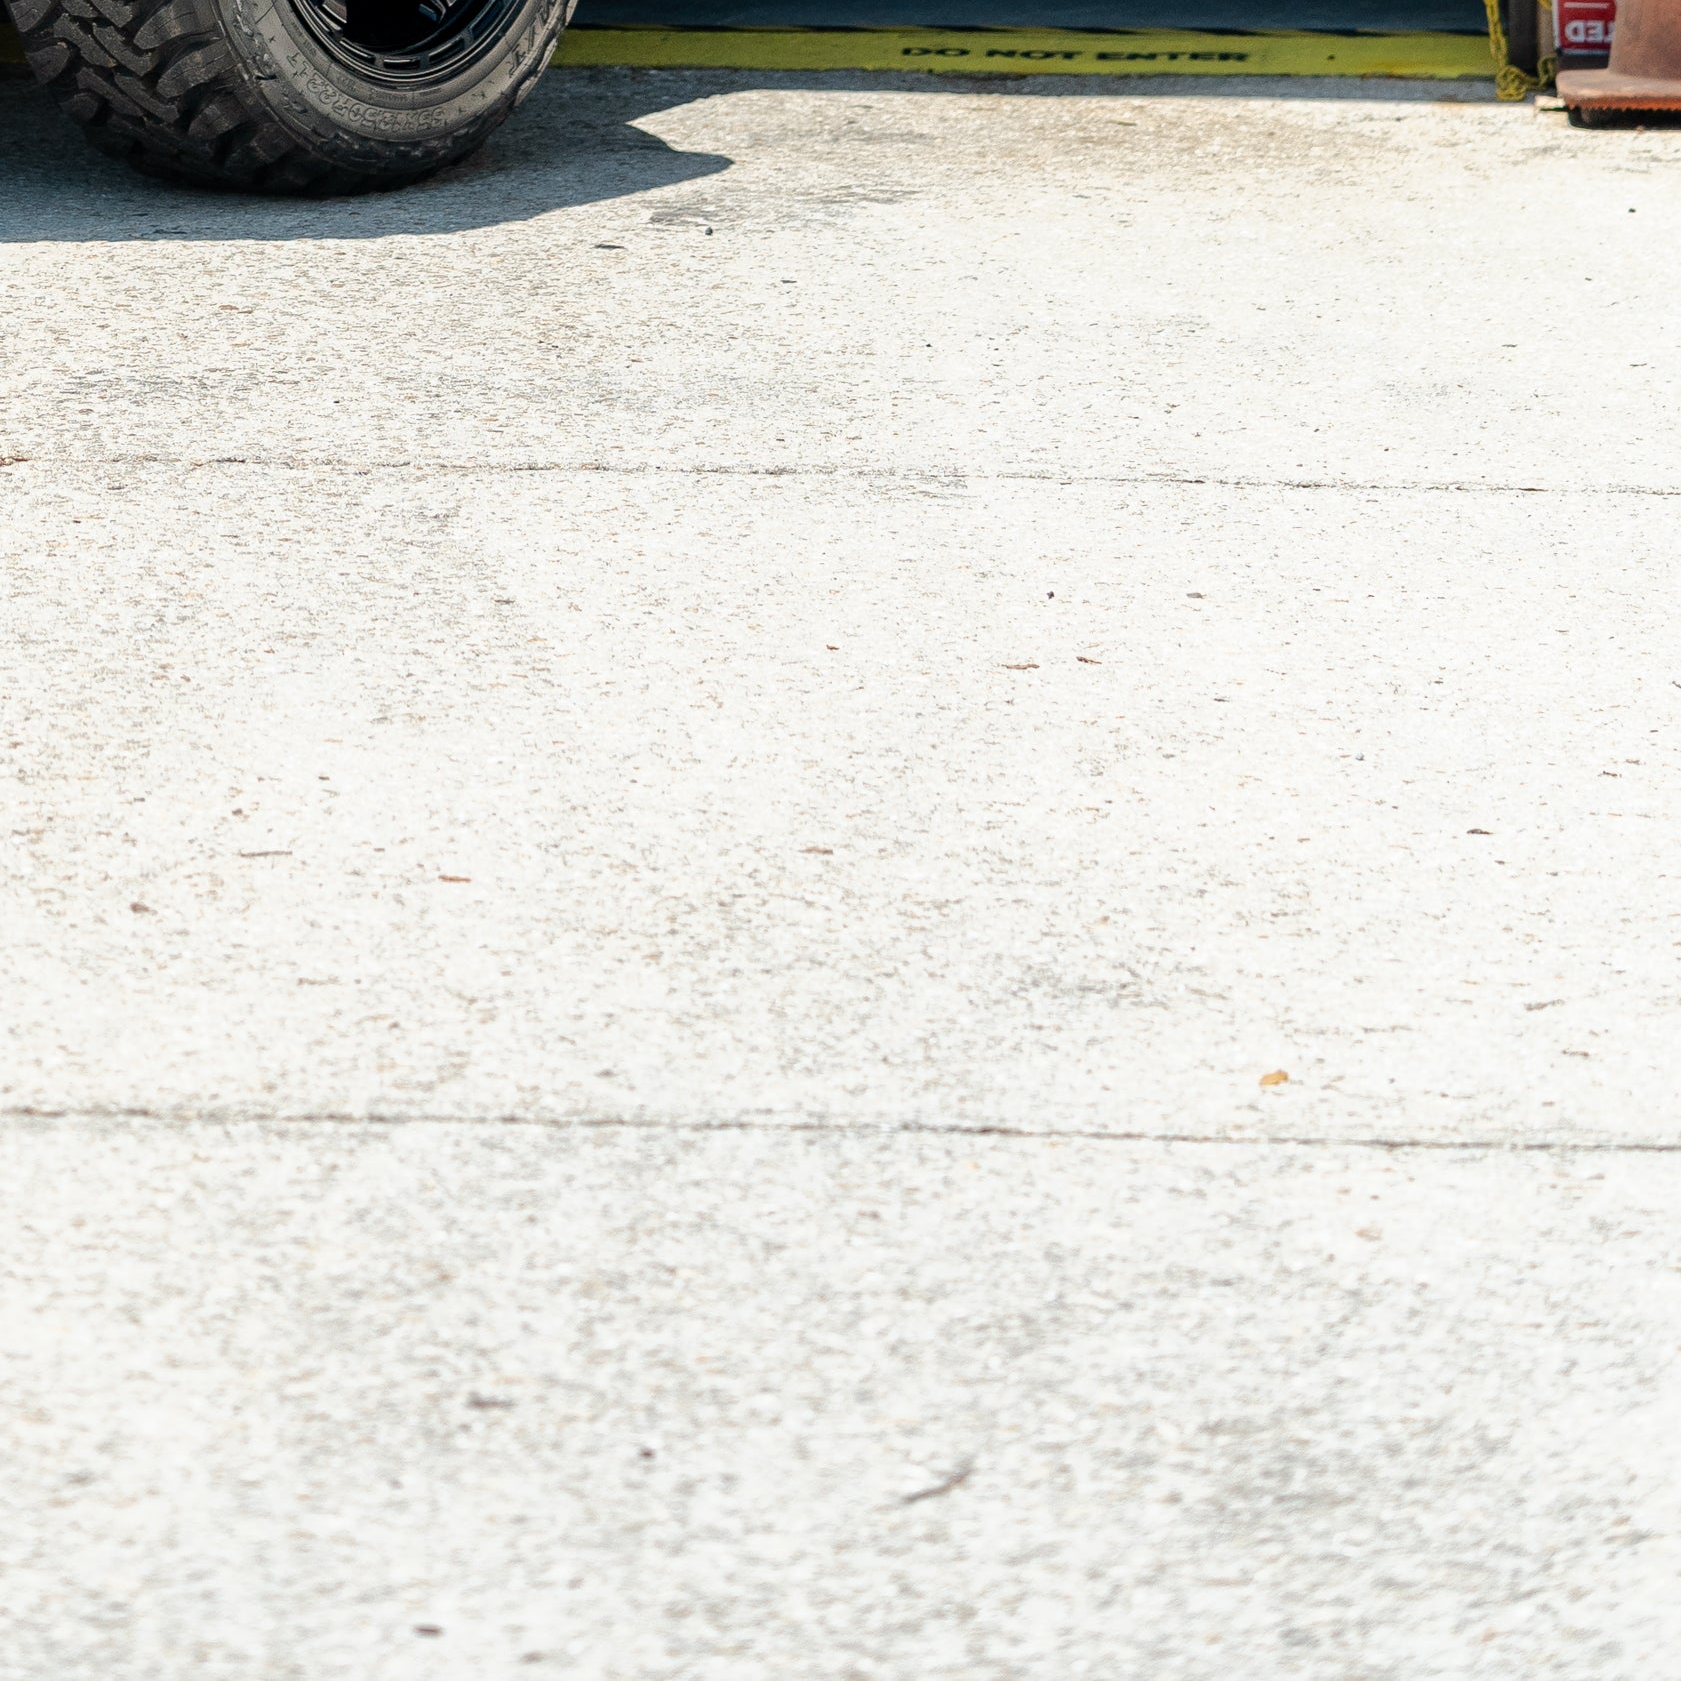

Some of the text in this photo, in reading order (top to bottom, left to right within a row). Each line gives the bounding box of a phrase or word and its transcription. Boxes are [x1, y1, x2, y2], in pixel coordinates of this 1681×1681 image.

[901, 47, 1250, 62] DO NOT ENTER
